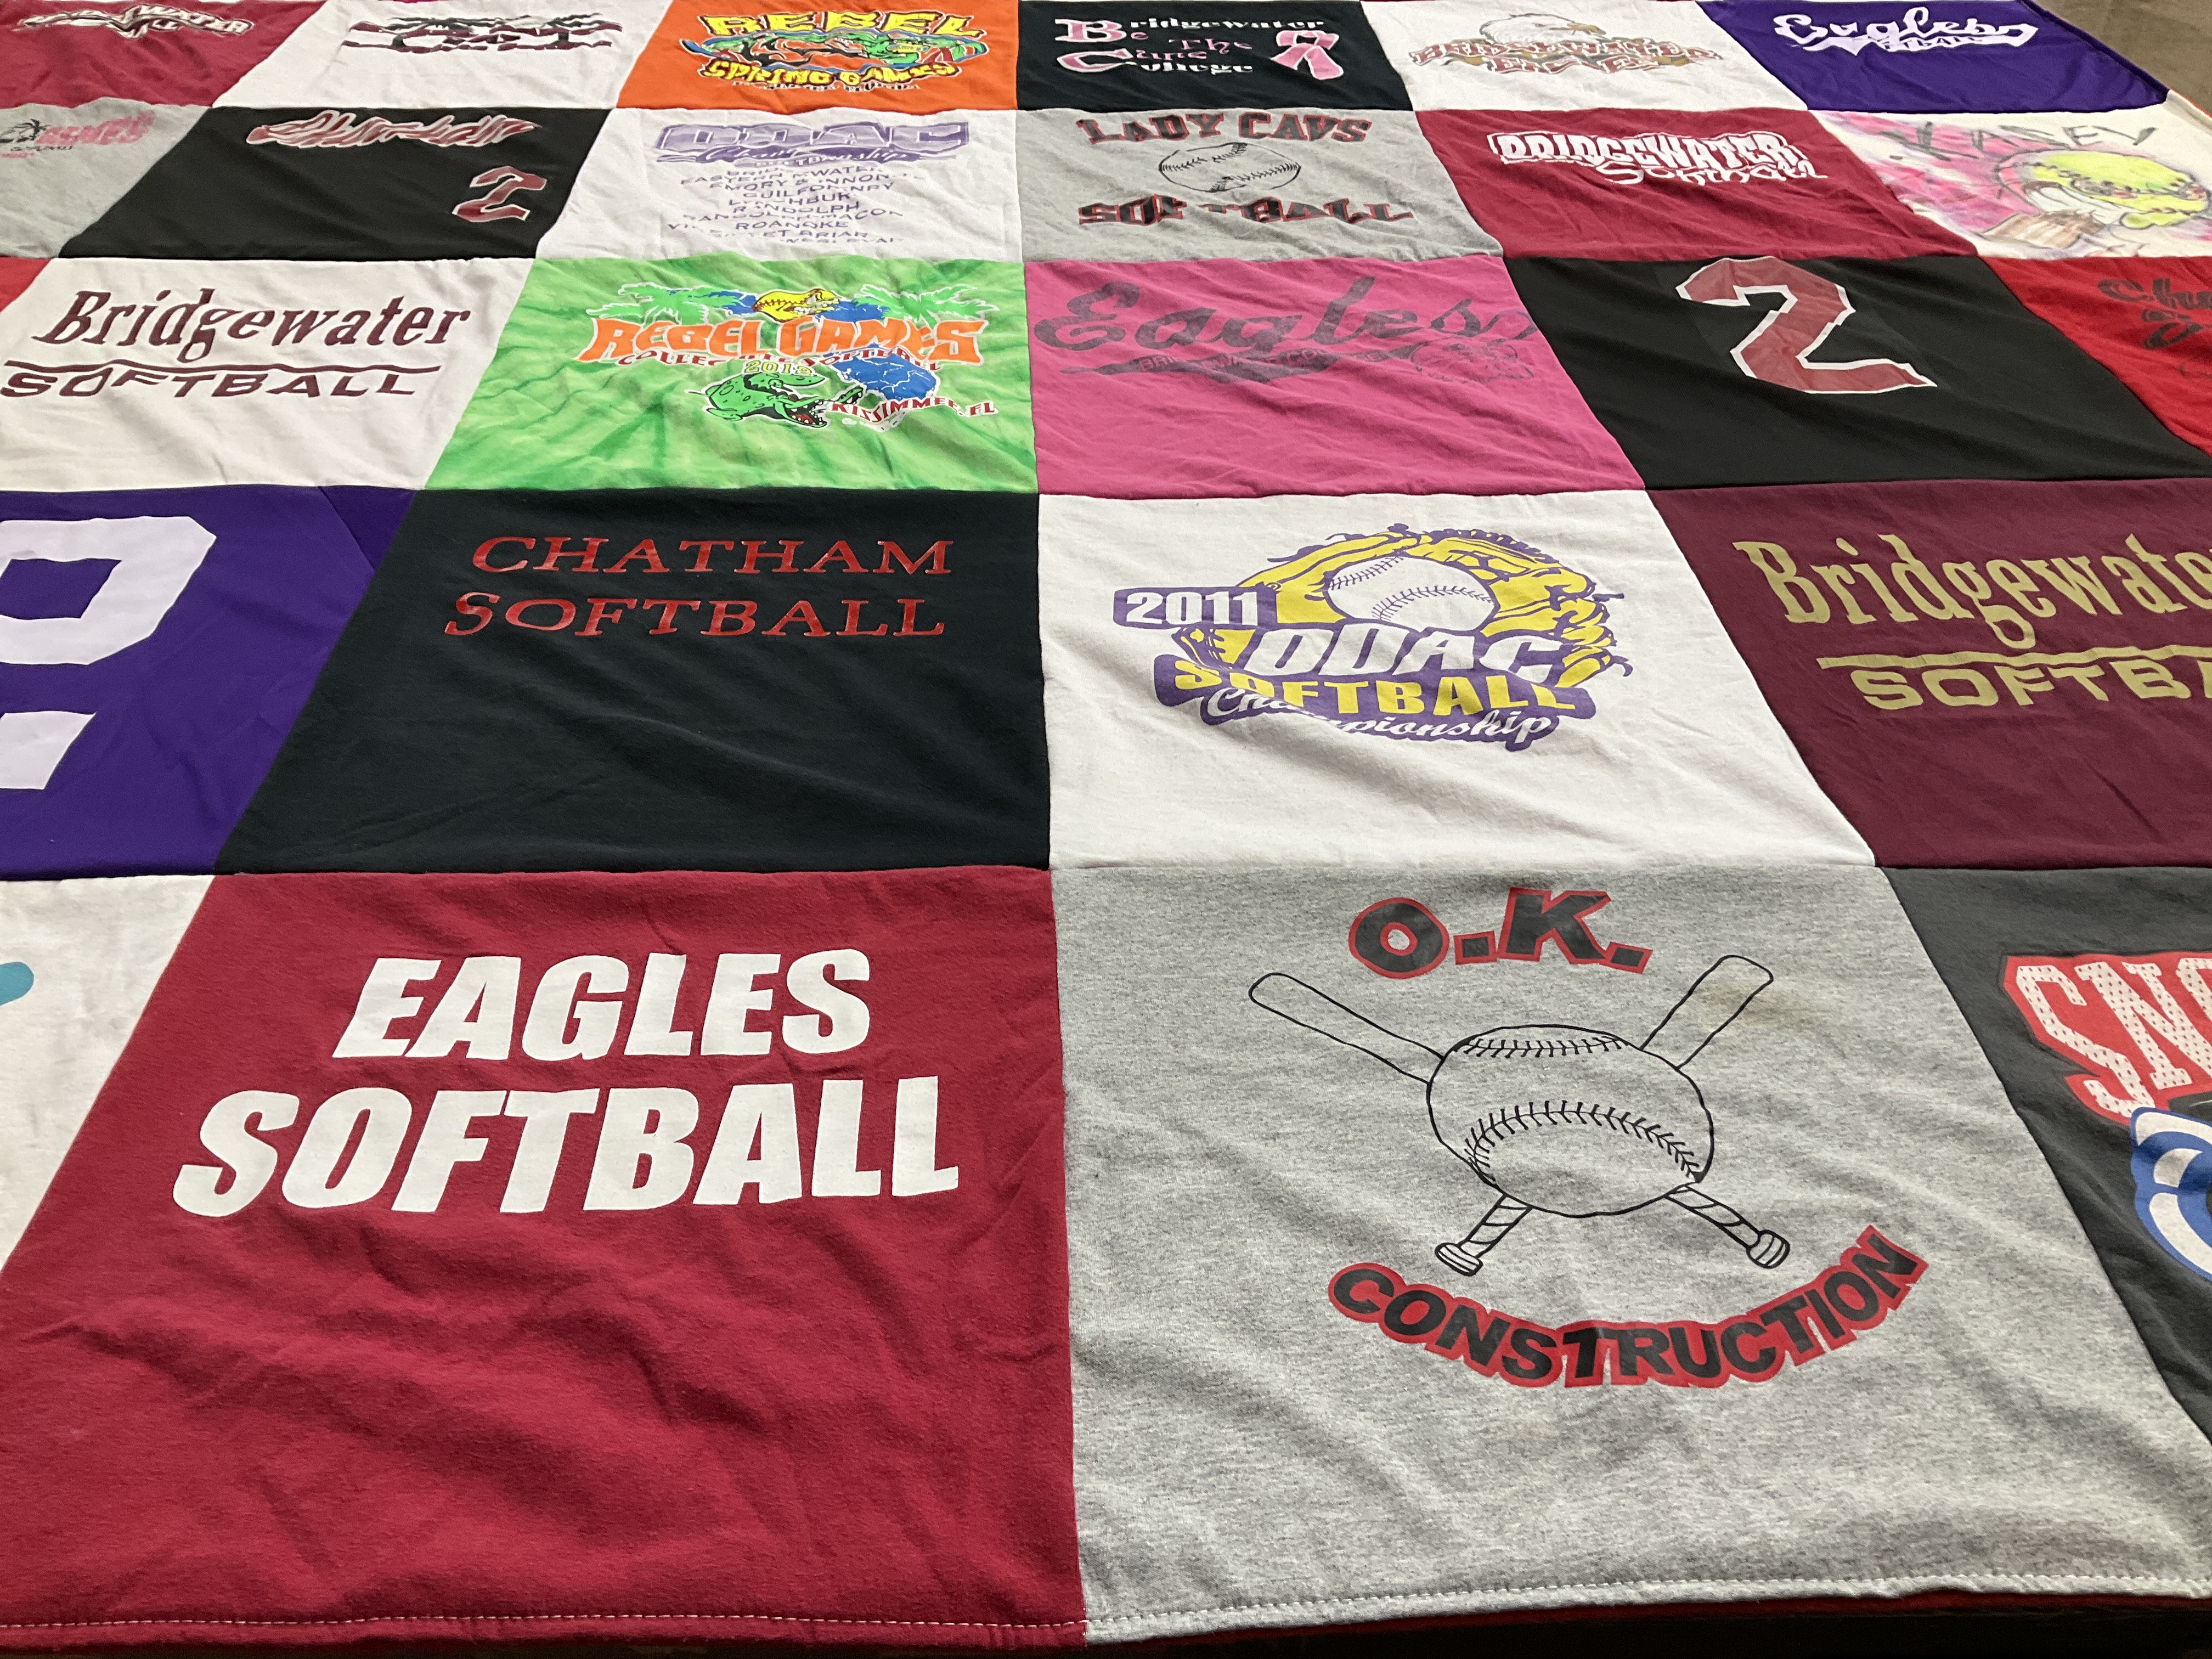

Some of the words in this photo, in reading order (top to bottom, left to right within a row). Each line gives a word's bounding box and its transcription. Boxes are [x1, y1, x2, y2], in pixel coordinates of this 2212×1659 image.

[701, 10, 986, 37] REBEL
[1169, 38, 1253, 54] The
[1076, 113, 1224, 144] LADY
[1238, 112, 1373, 142] CAVS
[452, 166, 548, 222] 2
[735, 220, 849, 230] ROANOKE
[31, 287, 471, 363] Bridgewater
[575, 318, 771, 362] REBEL
[777, 317, 988, 364] GAMES
[1034, 275, 1484, 352] Eagles
[1675, 256, 1938, 394] 2
[0, 367, 415, 398] SOFTBALL
[471, 536, 954, 574] CHATHAM
[444, 591, 945, 636] SOFTBALL
[1125, 589, 1259, 626] 2011
[1239, 623, 1565, 687] ODAC
[1174, 657, 1576, 716] SOFTBALL
[1850, 658, 2212, 710] SOFTB
[1347, 886, 1653, 979] O.K.
[332, 948, 870, 1062] EAGLES
[172, 1075, 960, 1217] SOFTBALL
[1328, 1225, 1929, 1389] CONSTRUCTION
